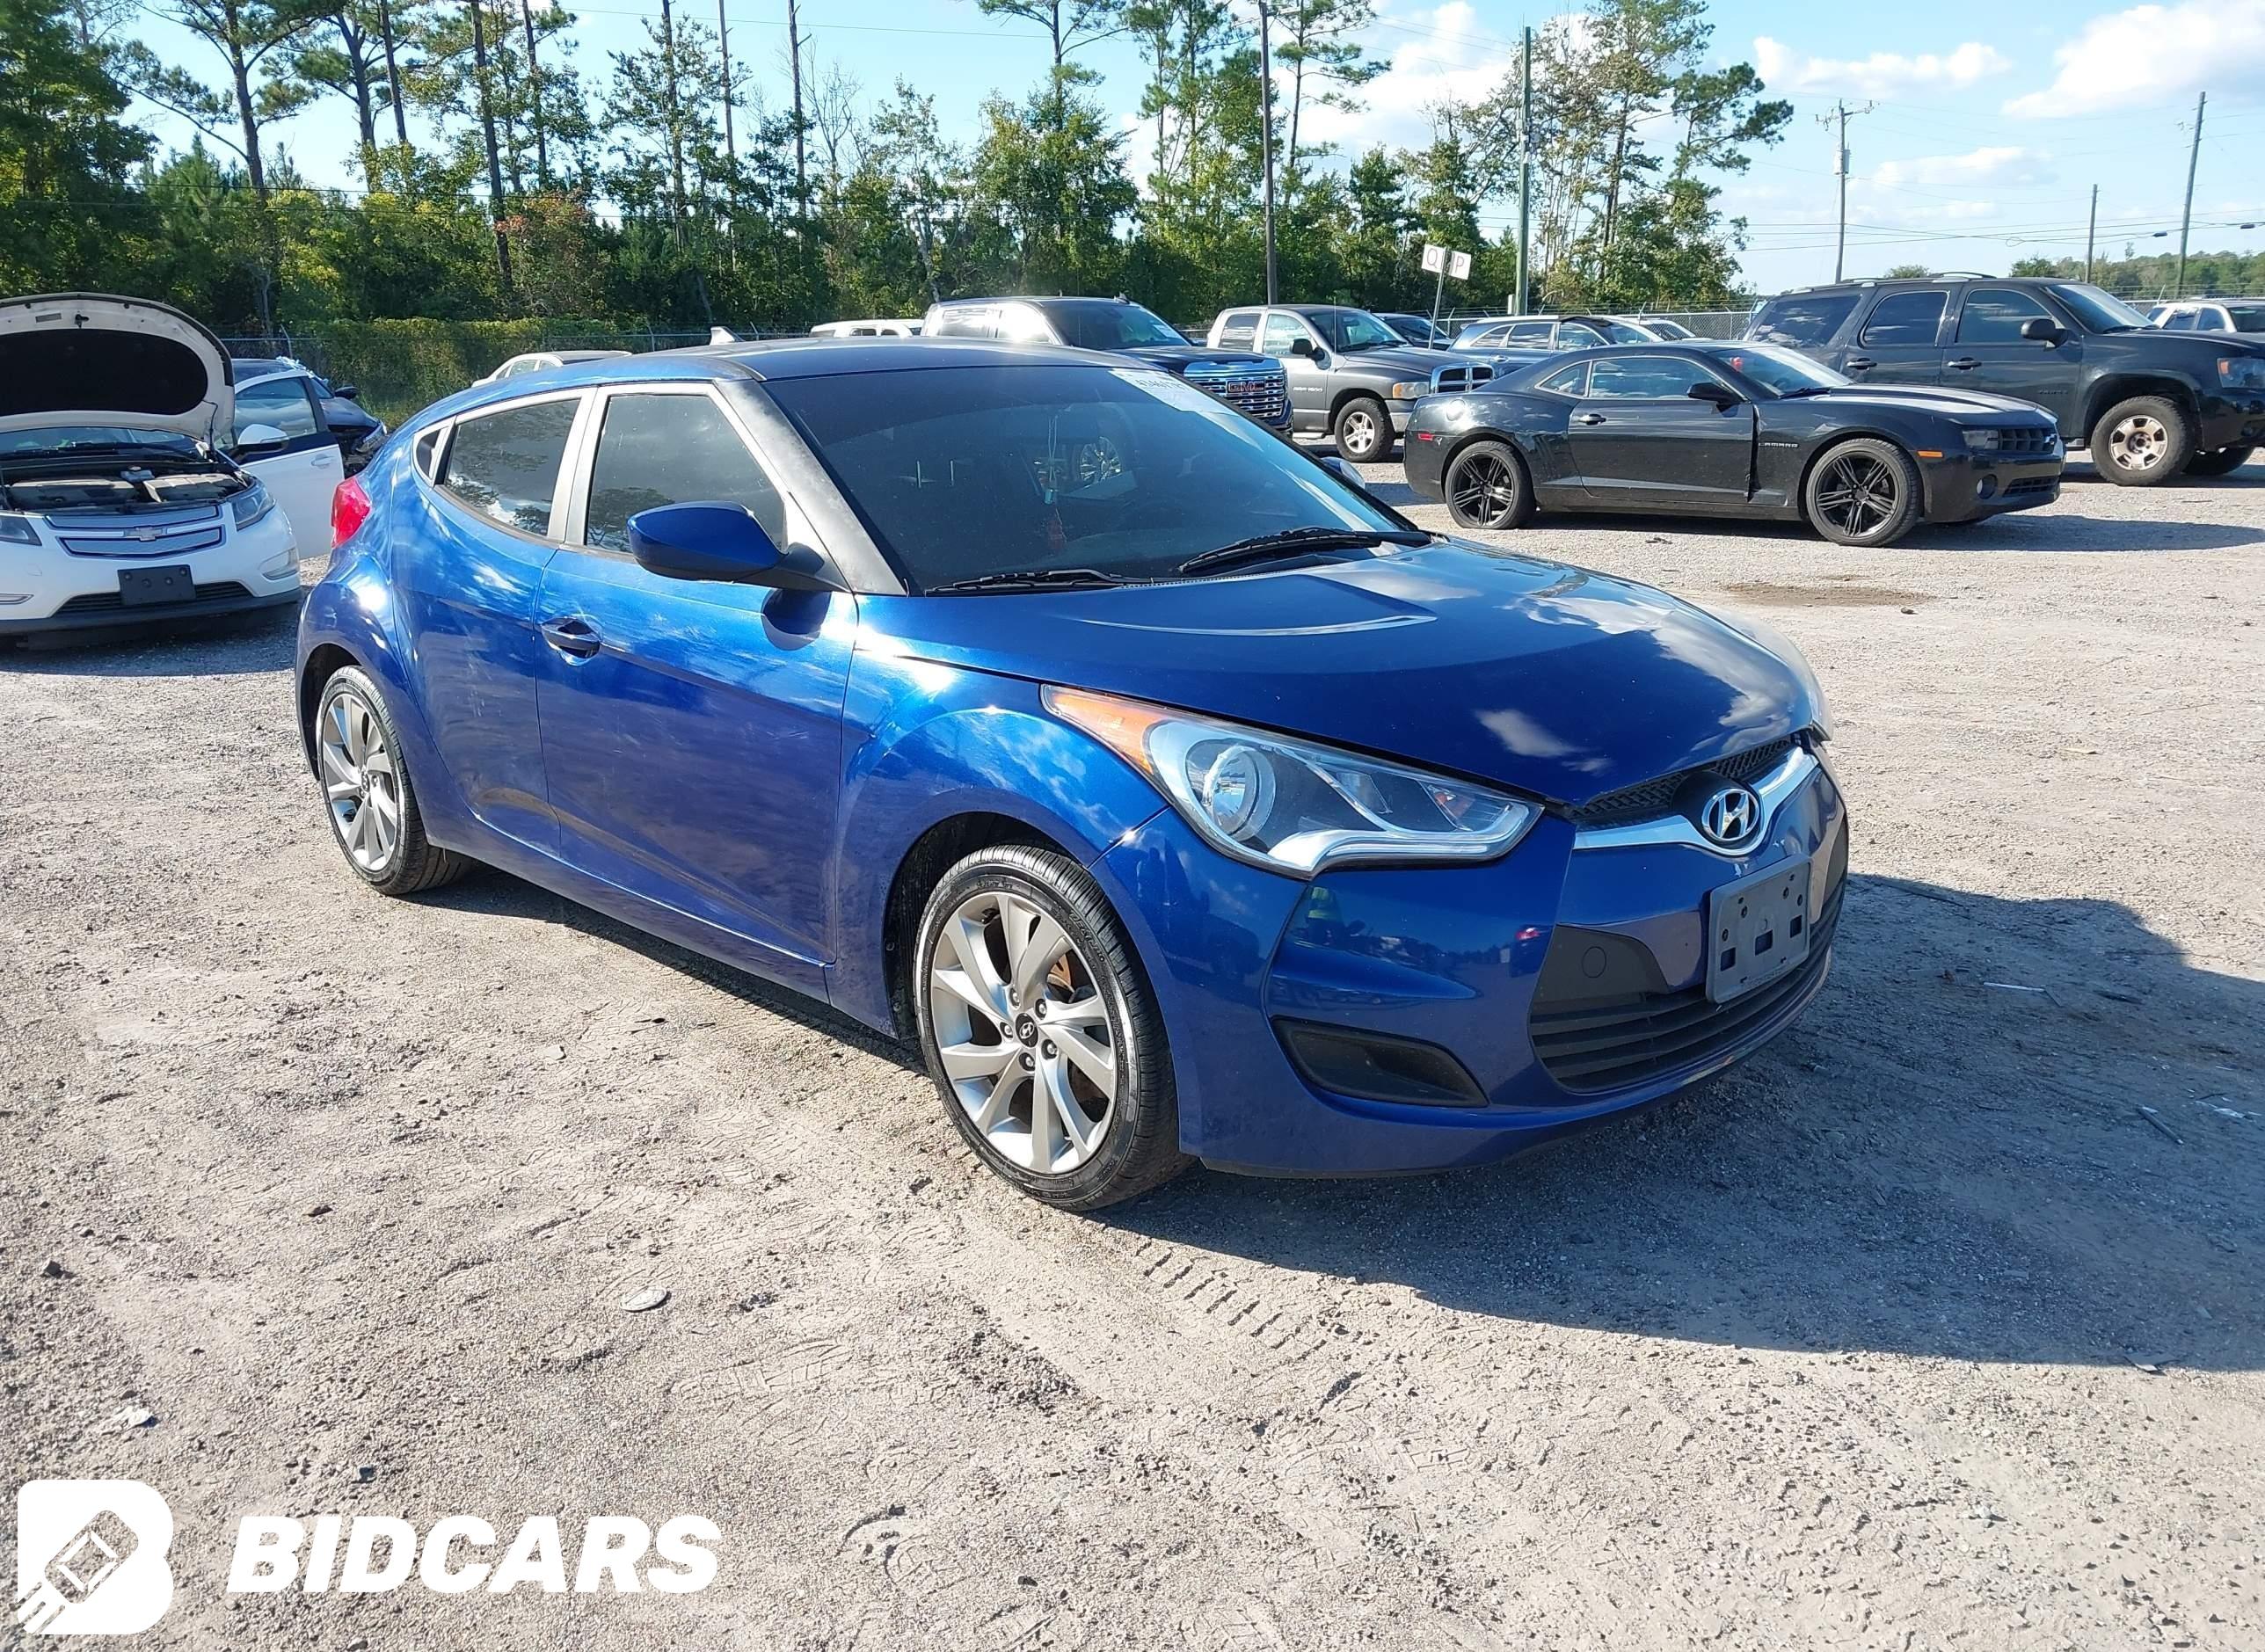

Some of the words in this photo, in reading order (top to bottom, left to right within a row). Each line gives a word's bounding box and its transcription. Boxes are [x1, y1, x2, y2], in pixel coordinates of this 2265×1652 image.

[1427, 248, 1438, 268] Q
[1455, 256, 1464, 273] P
[1227, 380, 1264, 392] GMC
